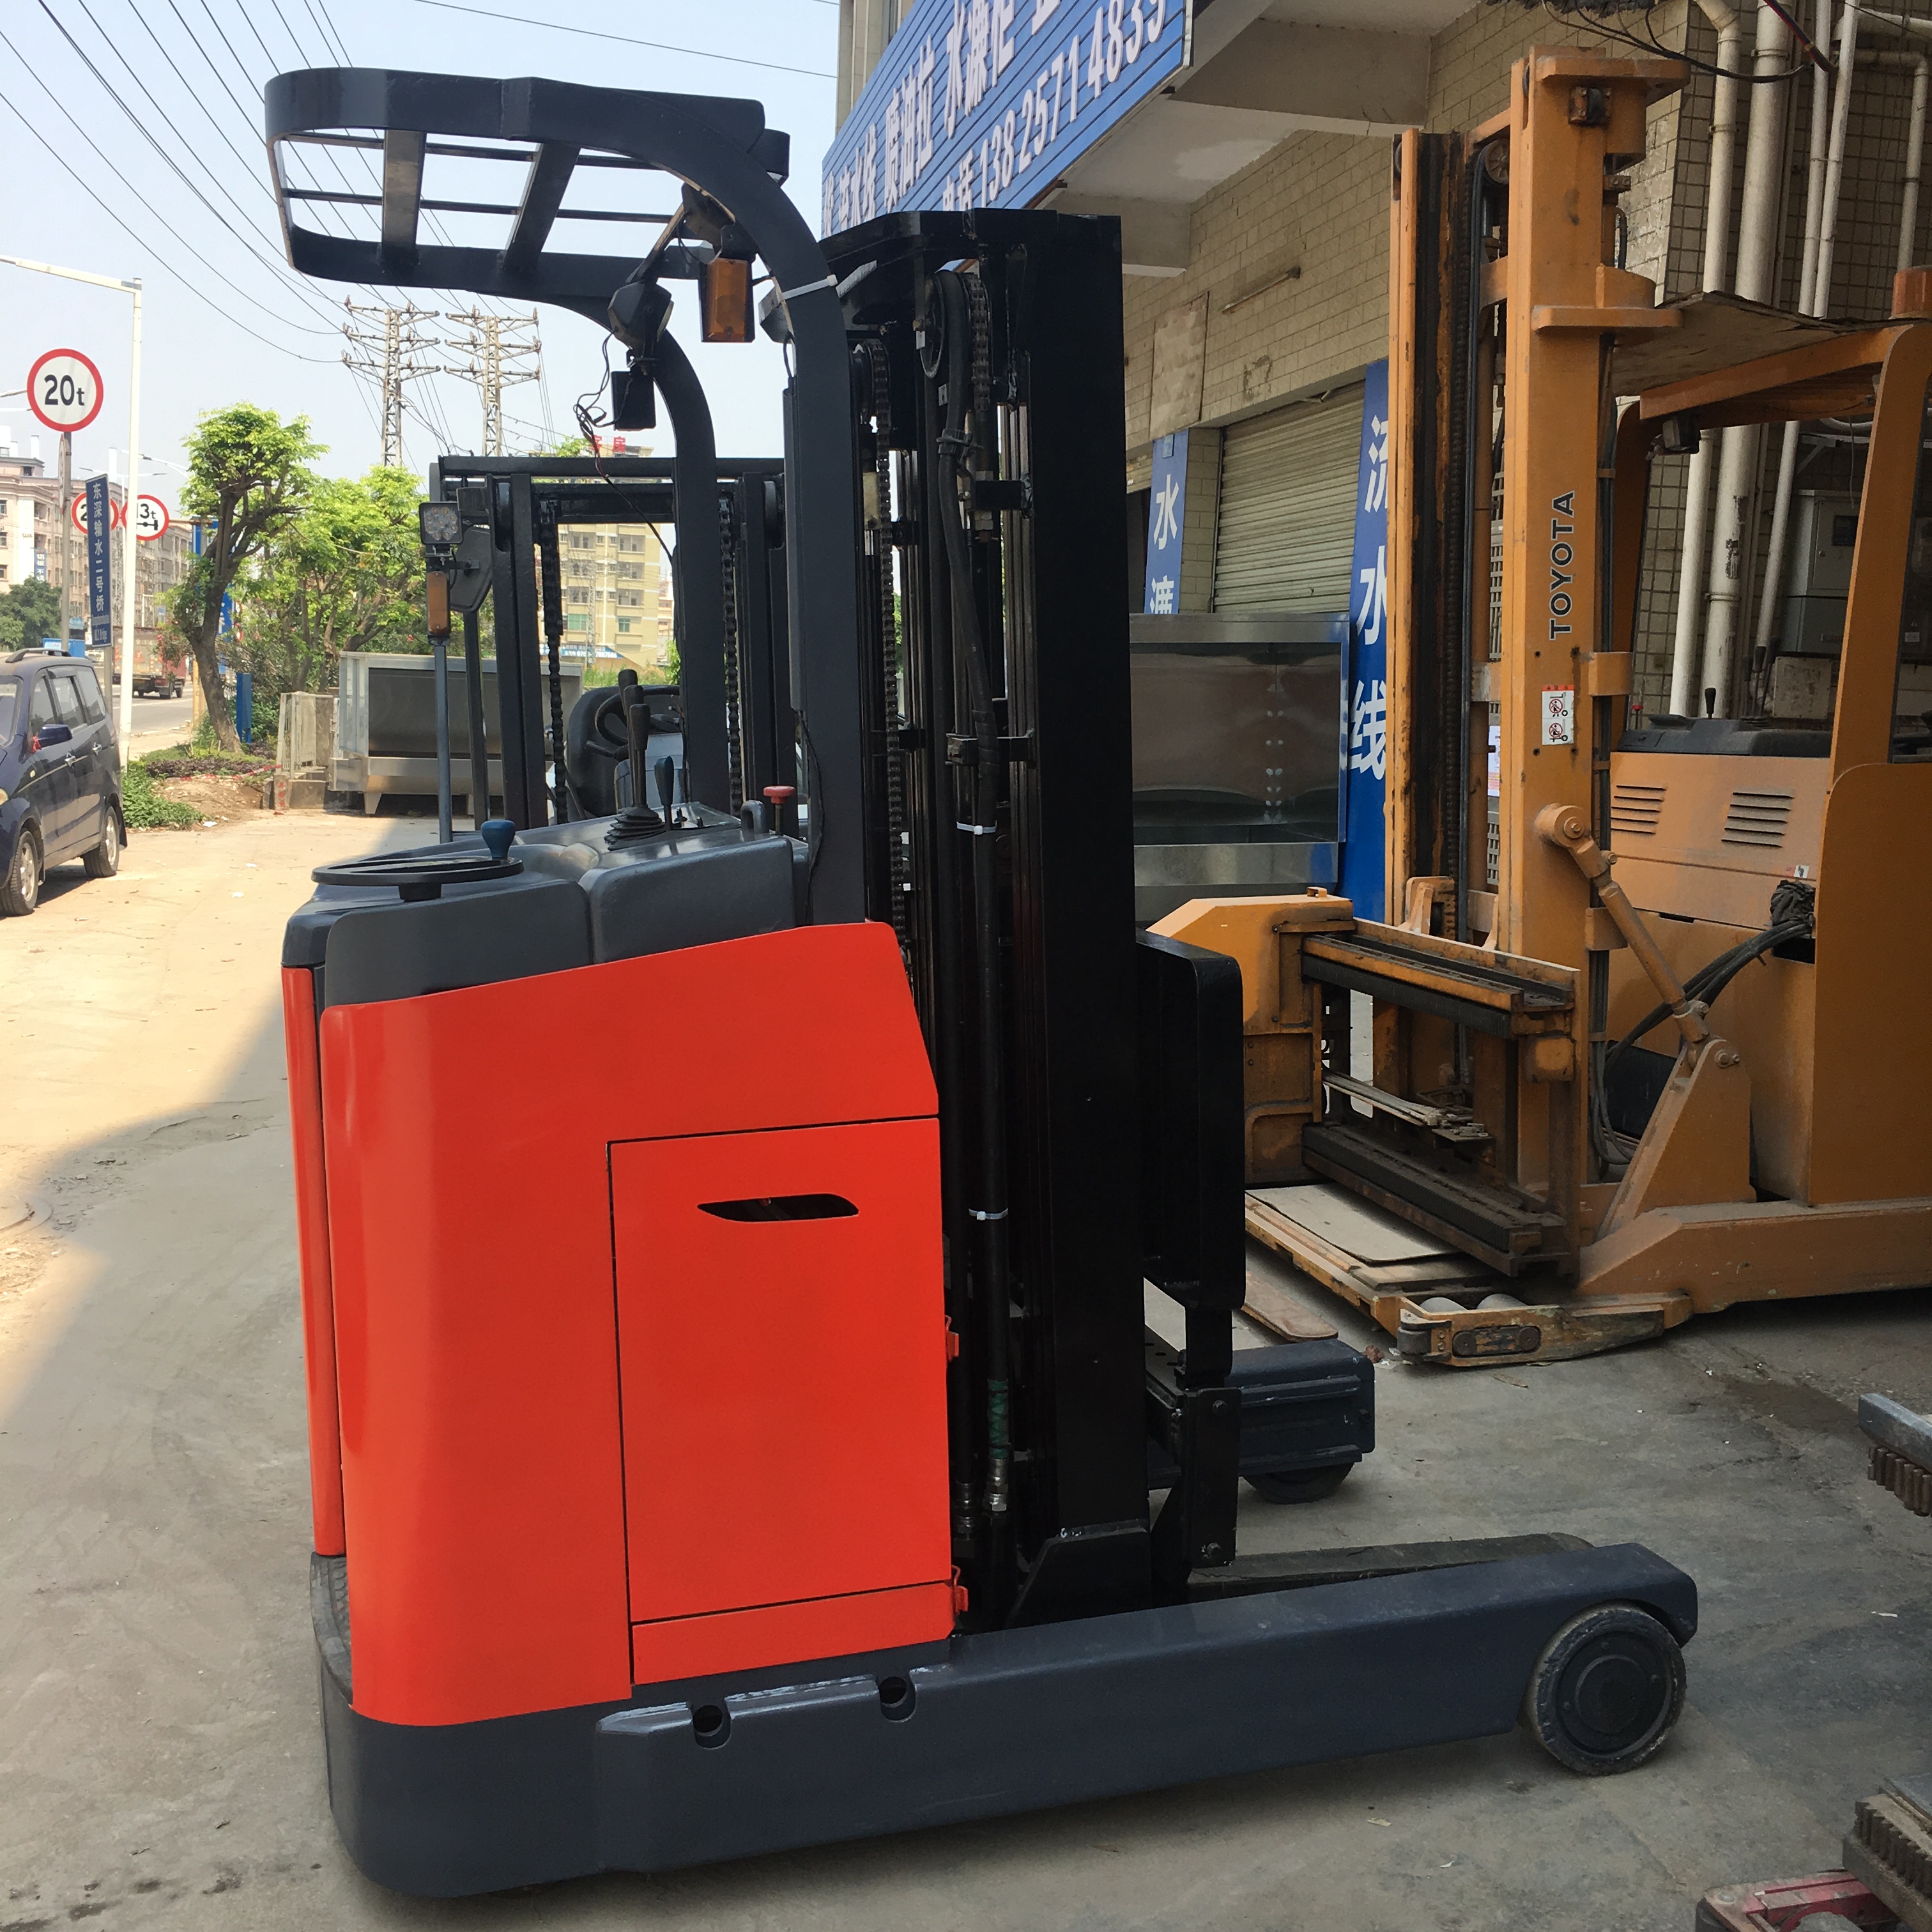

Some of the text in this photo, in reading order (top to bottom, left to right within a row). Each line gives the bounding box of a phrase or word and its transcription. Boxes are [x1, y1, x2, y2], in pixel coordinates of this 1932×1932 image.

[884, 34, 935, 214] 喷油拉
[979, 109, 1016, 208] 138
[1019, 34, 1080, 174] 2571
[44, 374, 85, 406] 20t
[93, 482, 105, 612] 东深输水二号桥
[1549, 490, 1575, 641] TOYOTA
